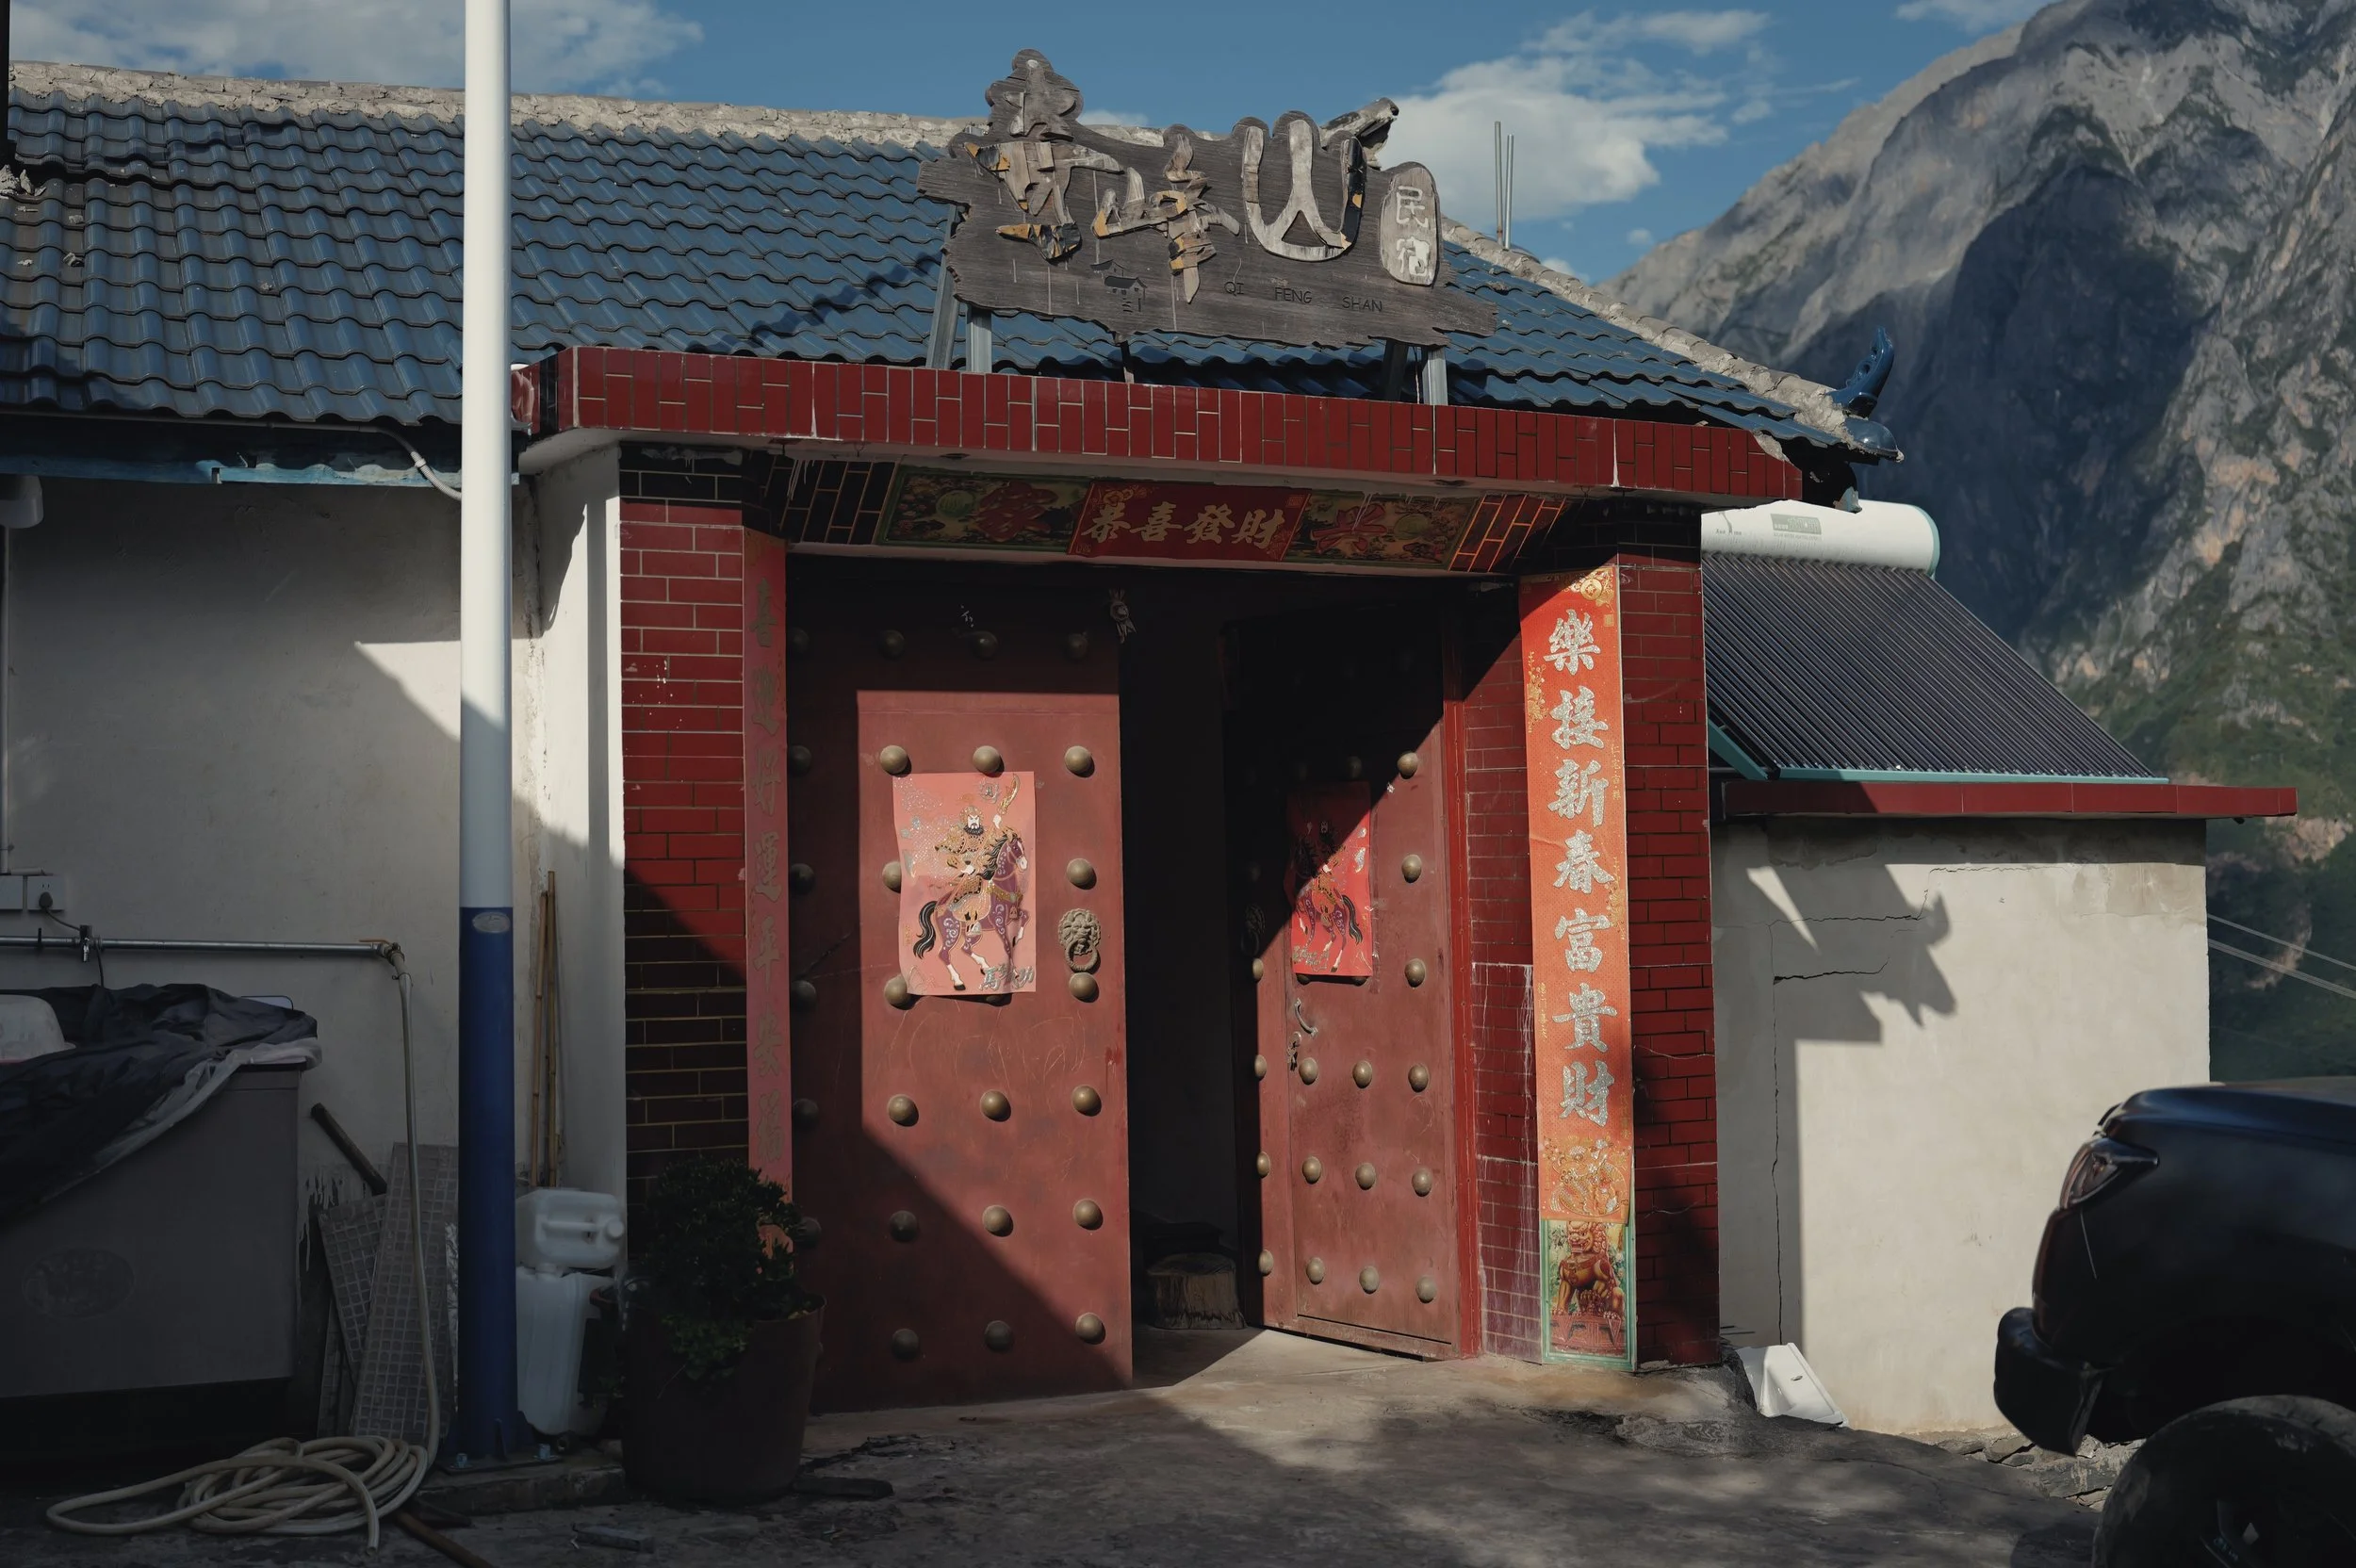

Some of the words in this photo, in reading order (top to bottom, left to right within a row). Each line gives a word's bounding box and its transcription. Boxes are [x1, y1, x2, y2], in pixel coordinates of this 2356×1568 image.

[1396, 185, 1431, 277] 民宿
[1224, 281, 1245, 296] QI
[1274, 286, 1313, 304] FENG
[1342, 296, 1383, 312] SHAN
[1081, 501, 1285, 549] 恭喜發財
[1543, 609, 1617, 1126] 樂接新春富貴財
